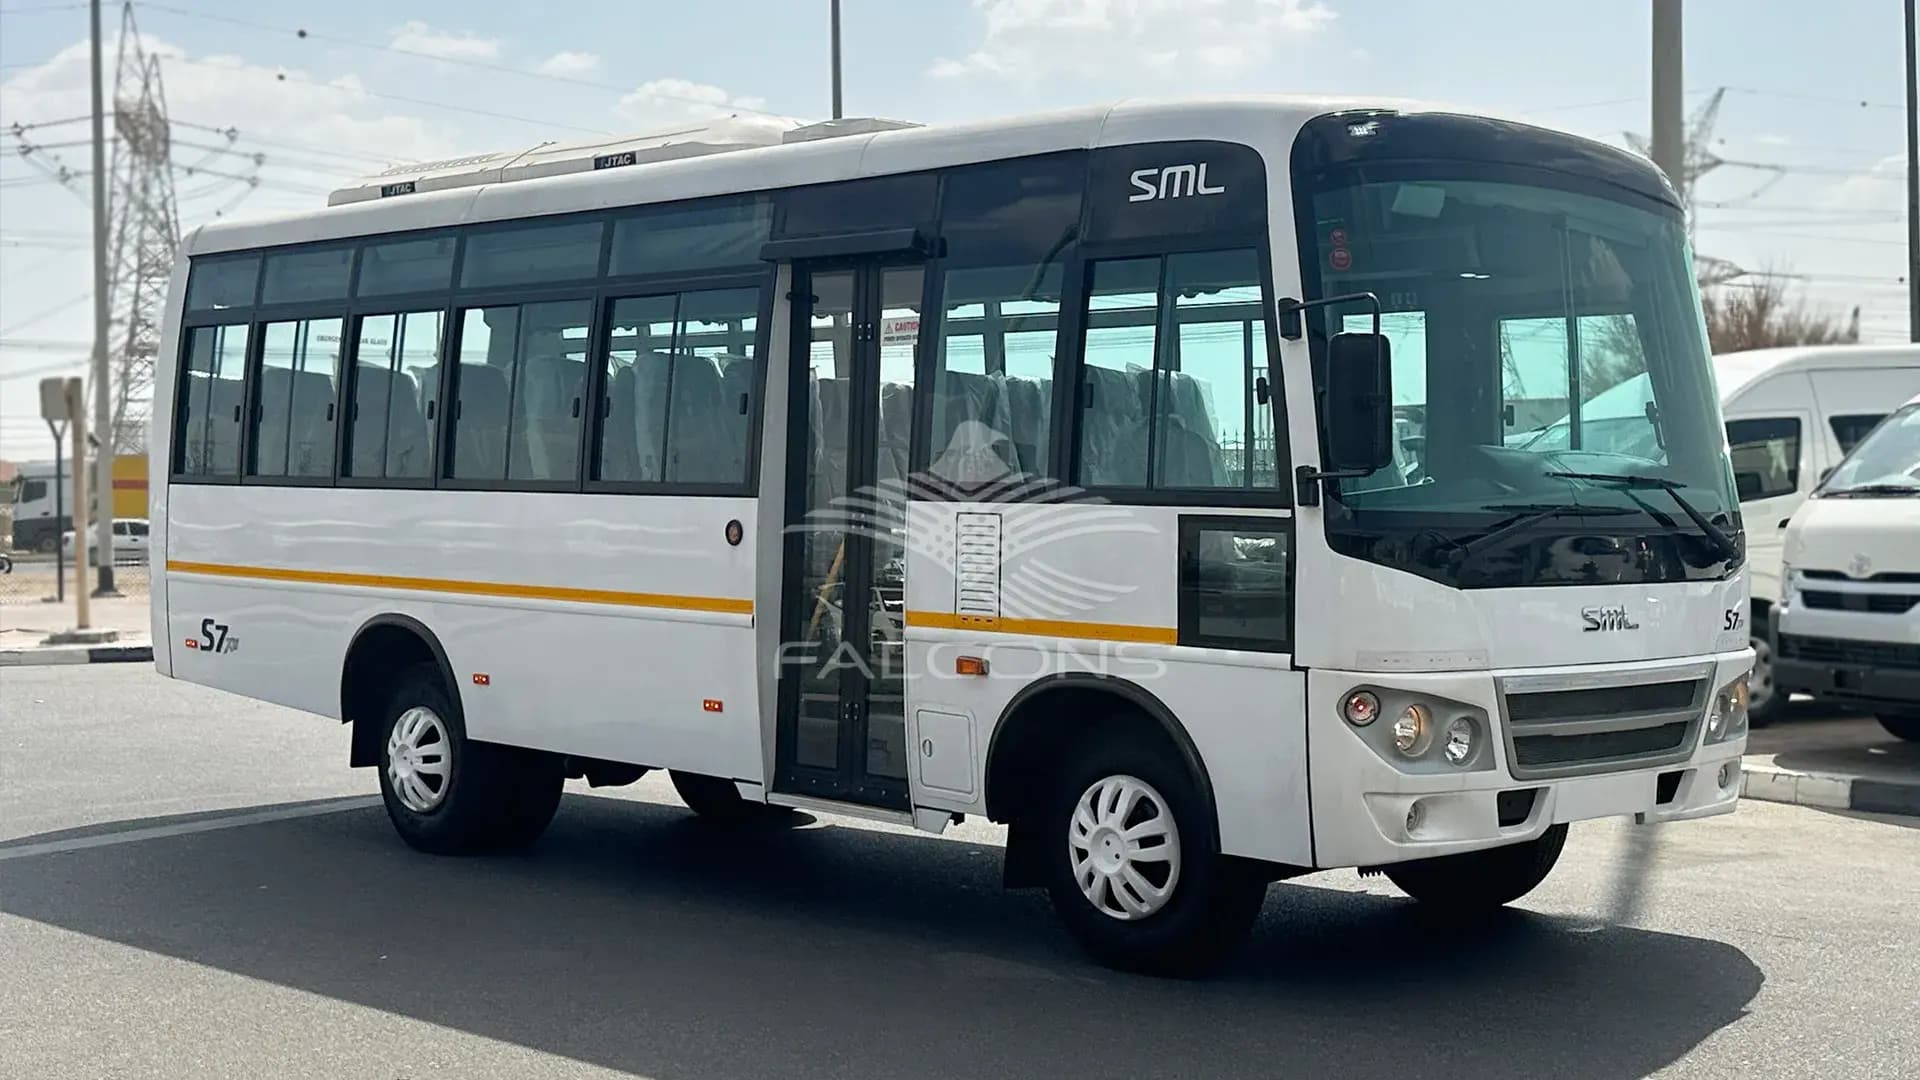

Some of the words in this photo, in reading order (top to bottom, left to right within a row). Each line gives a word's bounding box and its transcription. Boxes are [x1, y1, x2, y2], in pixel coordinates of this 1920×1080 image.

[603, 153, 631, 167] JTAC
[1129, 163, 1225, 202] SML
[1581, 604, 1639, 632] SML
[1723, 609, 1740, 631] S7
[200, 618, 229, 654] S7
